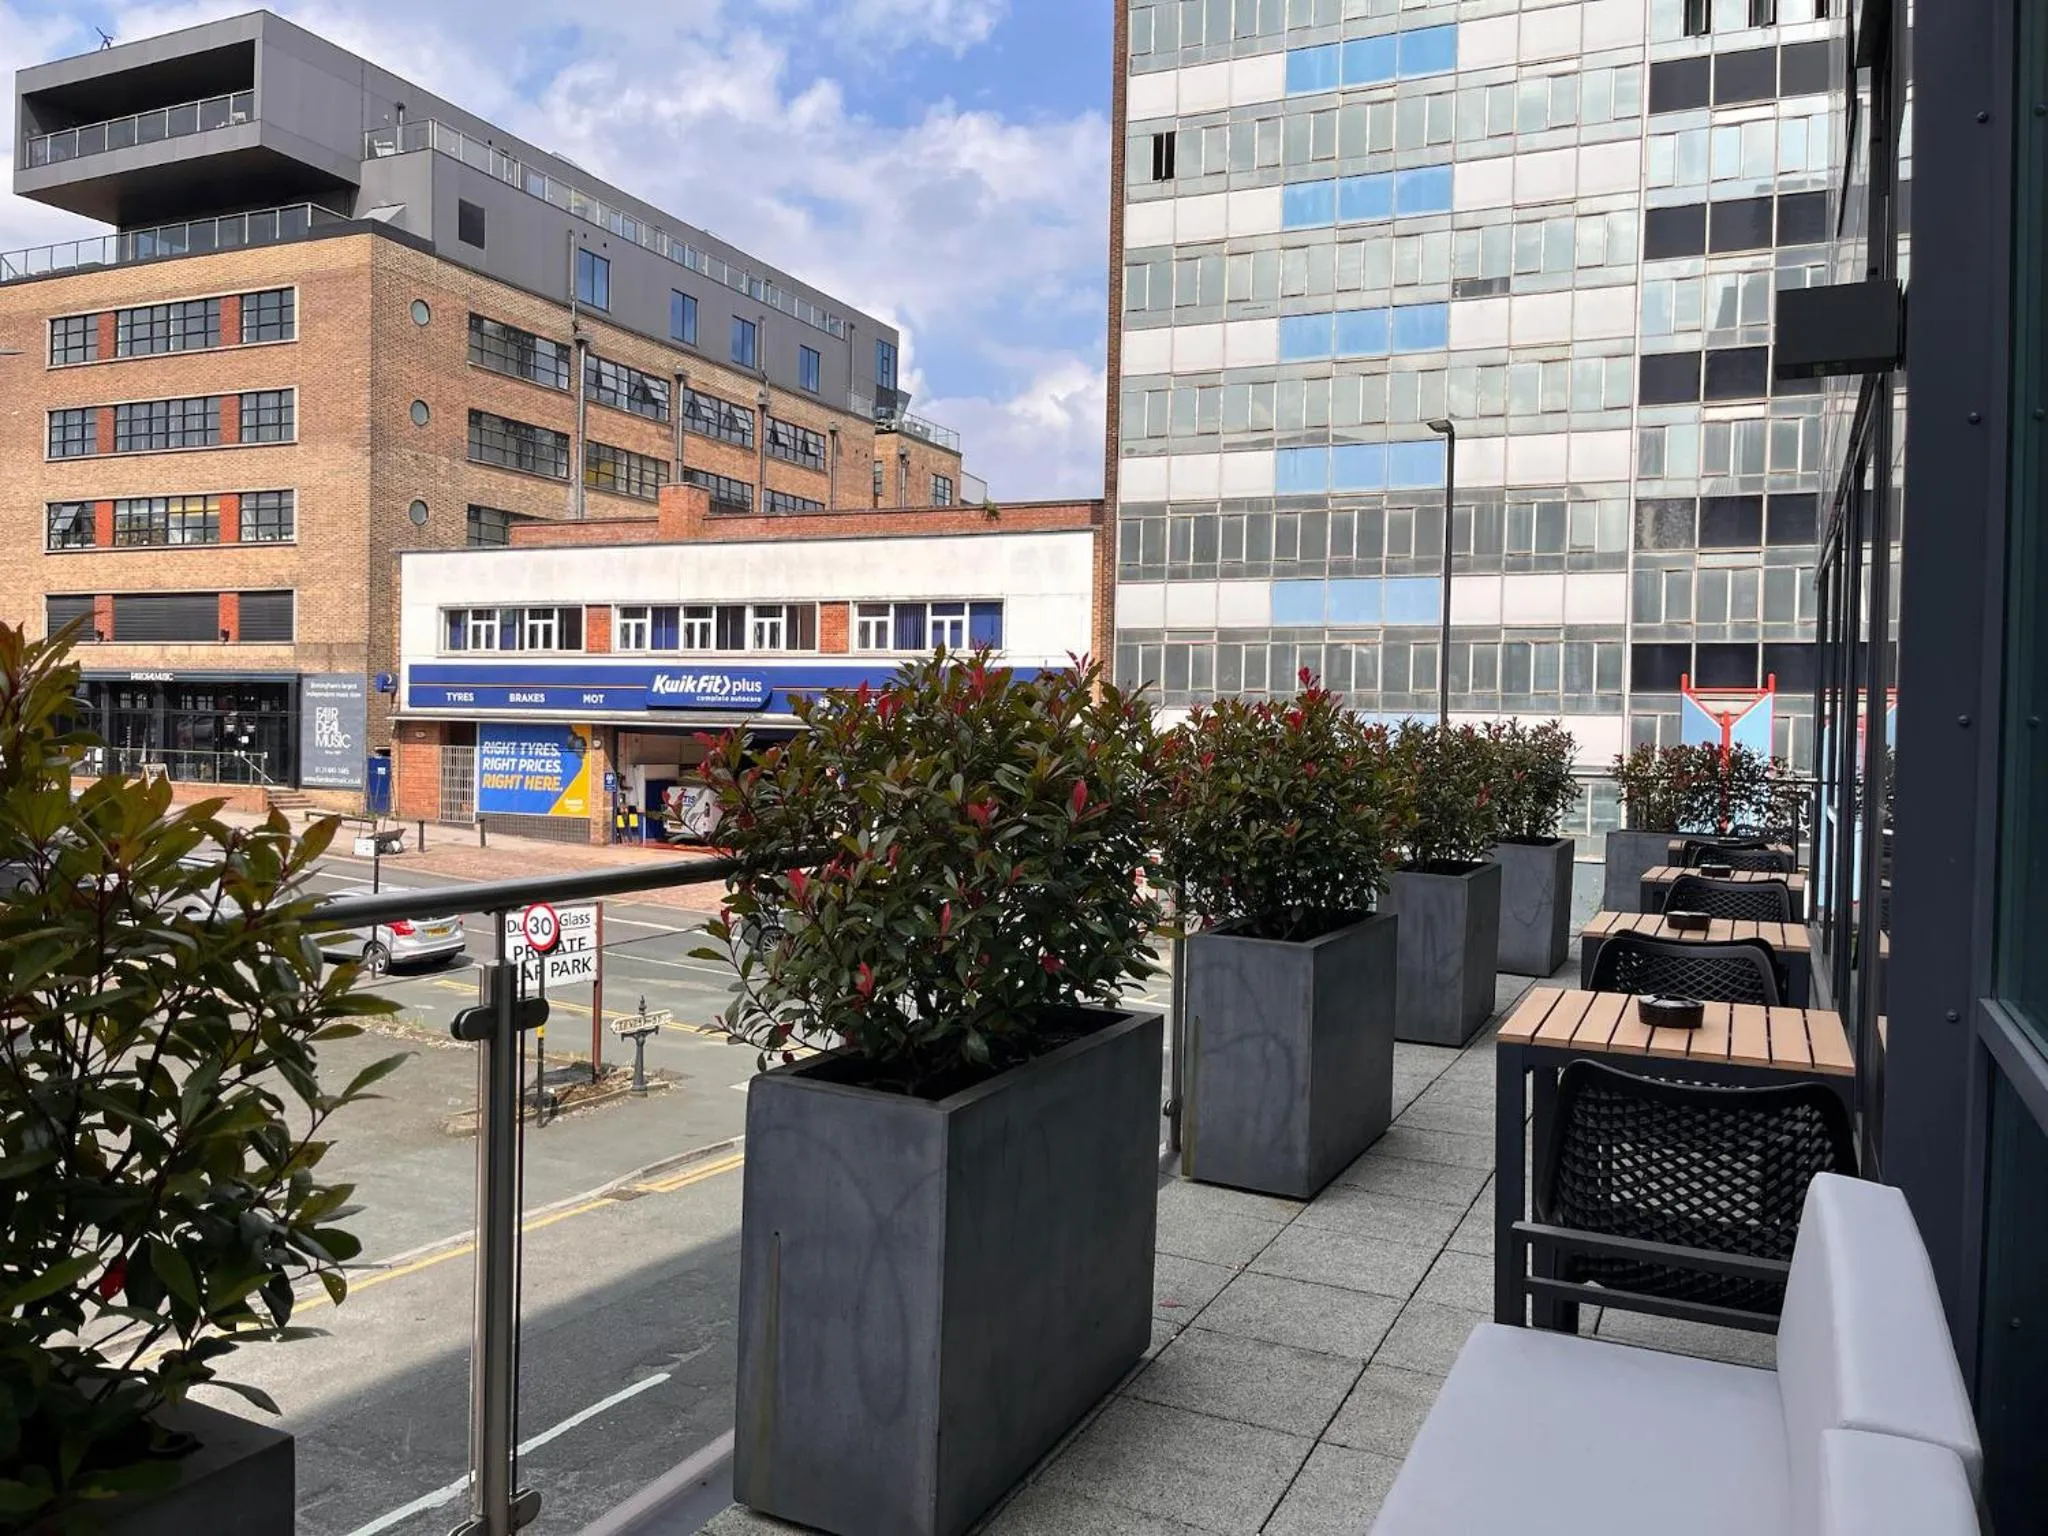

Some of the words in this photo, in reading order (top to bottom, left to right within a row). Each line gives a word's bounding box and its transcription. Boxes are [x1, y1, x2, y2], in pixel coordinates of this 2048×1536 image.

[732, 678, 762, 695] plus
[446, 692, 474, 702] TYRES
[509, 693, 546, 703] BRAKES
[583, 694, 605, 704] MOT
[315, 706, 339, 720] FAIR
[482, 741, 517, 755] RIGHT
[519, 742, 561, 757] TYRES.
[482, 757, 518, 771] RIGHT
[518, 759, 563, 774] PRICES.
[482, 774, 523, 790] RIGHT
[523, 775, 563, 792] HERE.
[529, 916, 552, 936] 30
[559, 912, 590, 926] Glass
[550, 956, 592, 978] PARK
